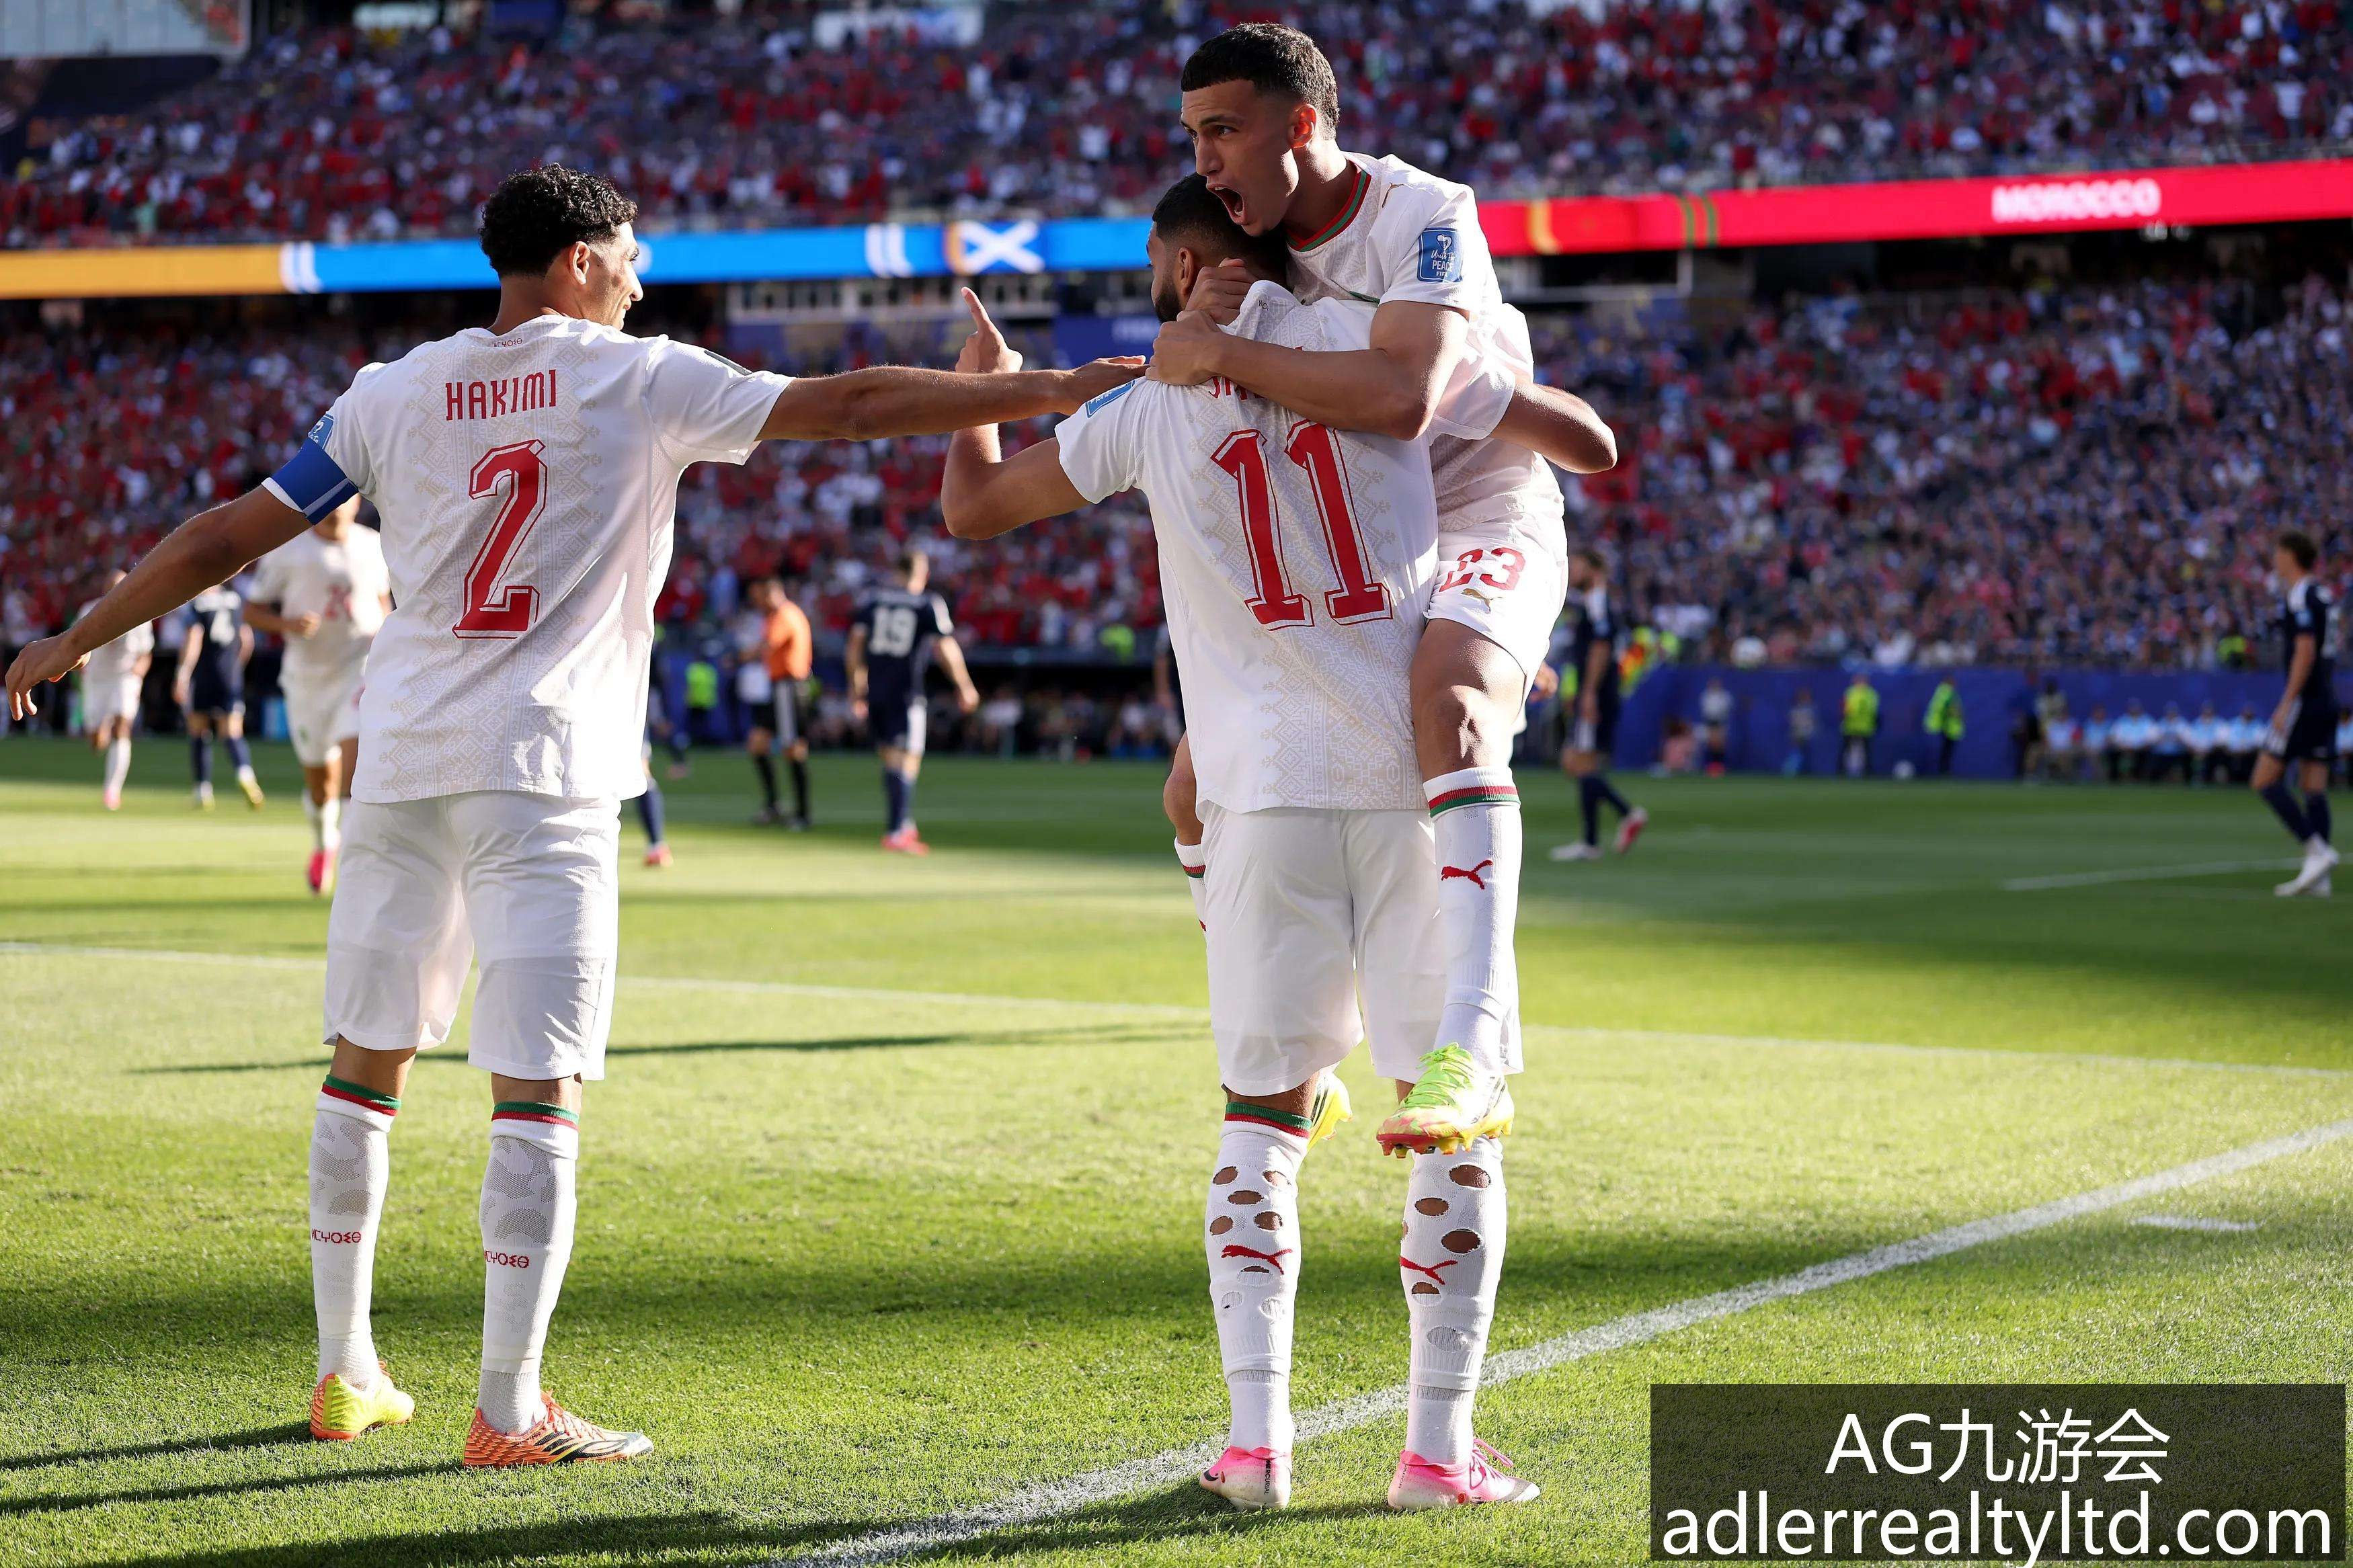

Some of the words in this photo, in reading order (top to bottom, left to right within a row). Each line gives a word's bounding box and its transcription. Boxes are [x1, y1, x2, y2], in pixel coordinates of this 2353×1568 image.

[1992, 178, 2161, 222] MOROCCO
[446, 370, 557, 421] HAKIMI
[452, 439, 548, 639] 2
[1210, 419, 1393, 632] 11
[1439, 547, 1526, 592] 23
[870, 606, 917, 657] 19
